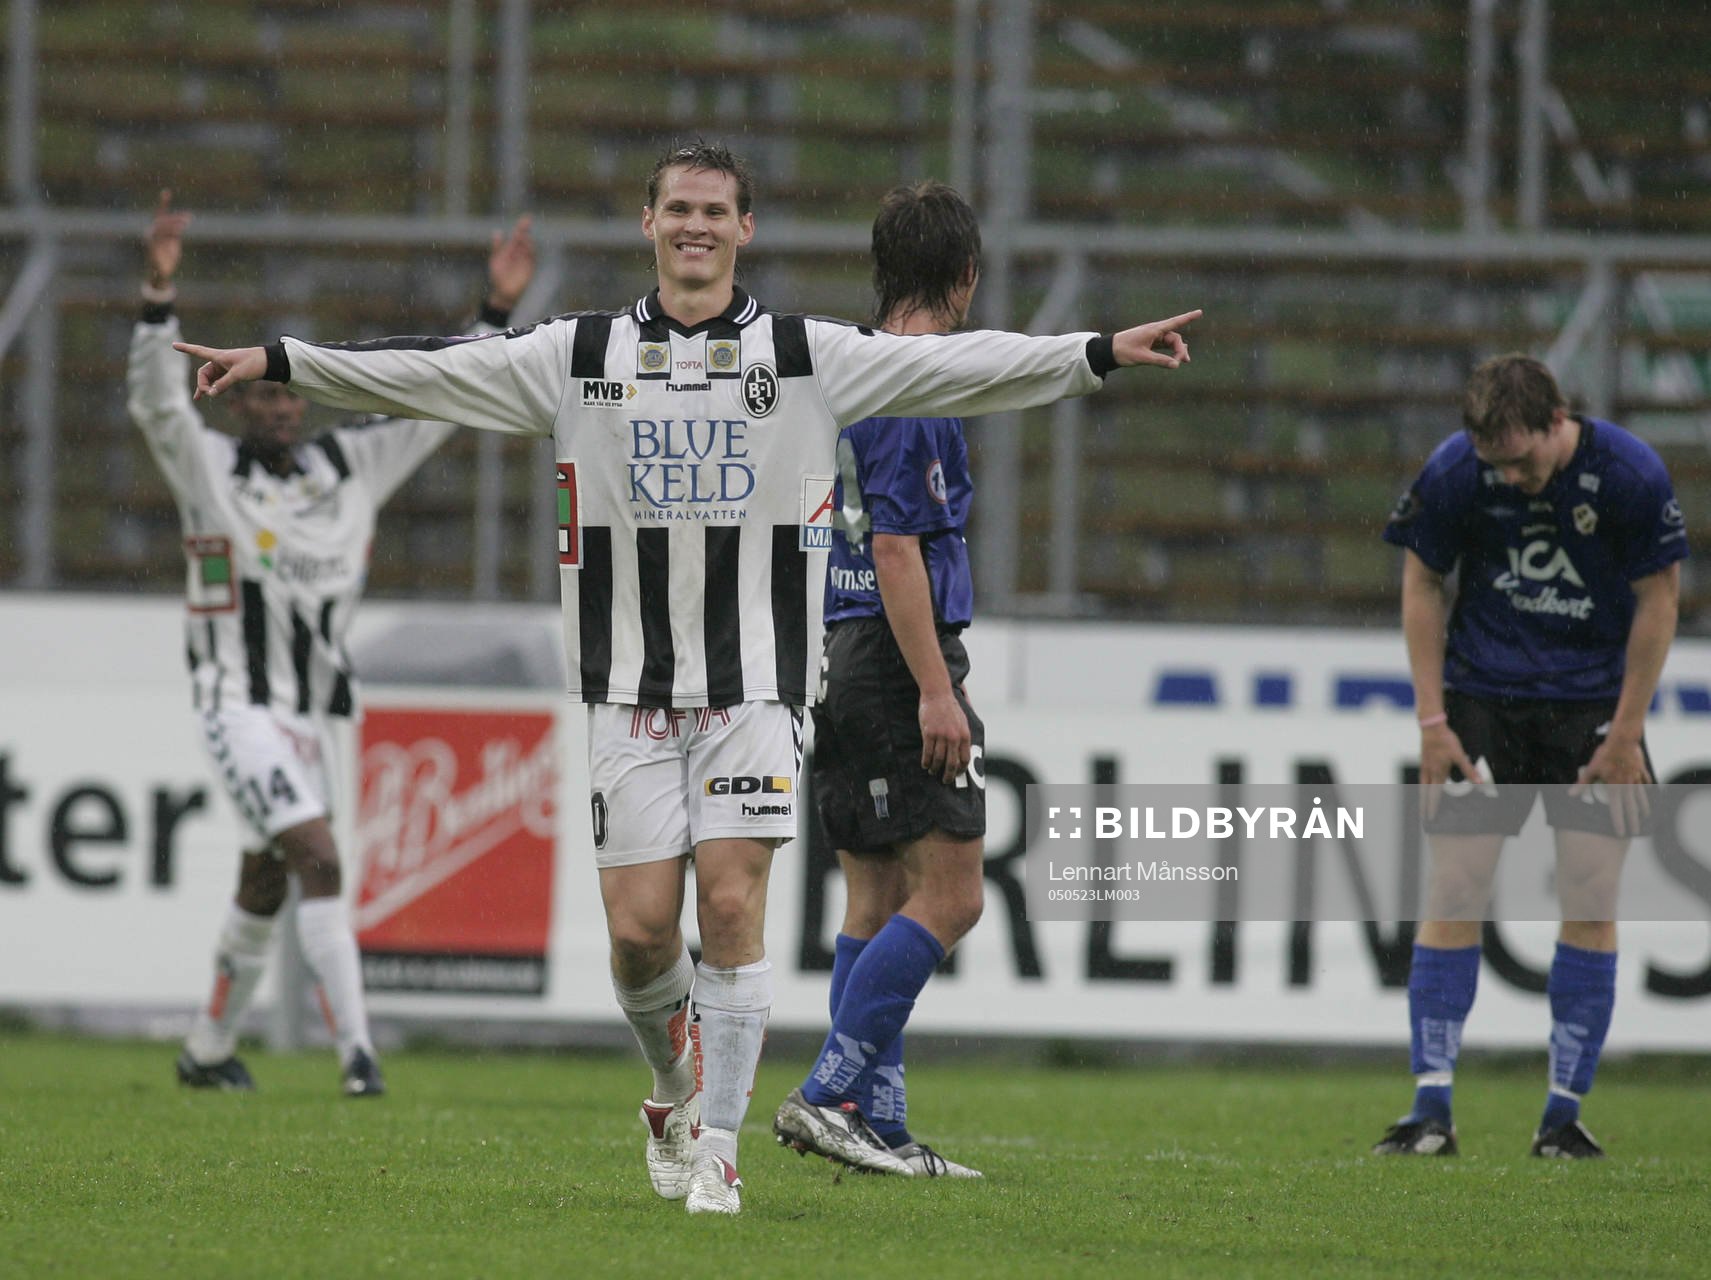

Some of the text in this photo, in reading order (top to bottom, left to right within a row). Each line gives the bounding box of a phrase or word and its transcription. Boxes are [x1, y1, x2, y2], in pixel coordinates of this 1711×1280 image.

[675, 361, 703, 370] TOFTA
[583, 381, 624, 400] MVB
[666, 381, 712, 392] hummel
[629, 419, 749, 460] BLUE
[626, 463, 756, 509] KELD
[634, 509, 747, 520] MINERALVATTEN
[1507, 539, 1586, 588] ICA
[249, 765, 300, 818] 14
[709, 775, 793, 794] GDL
[742, 803, 791, 816] hummel
